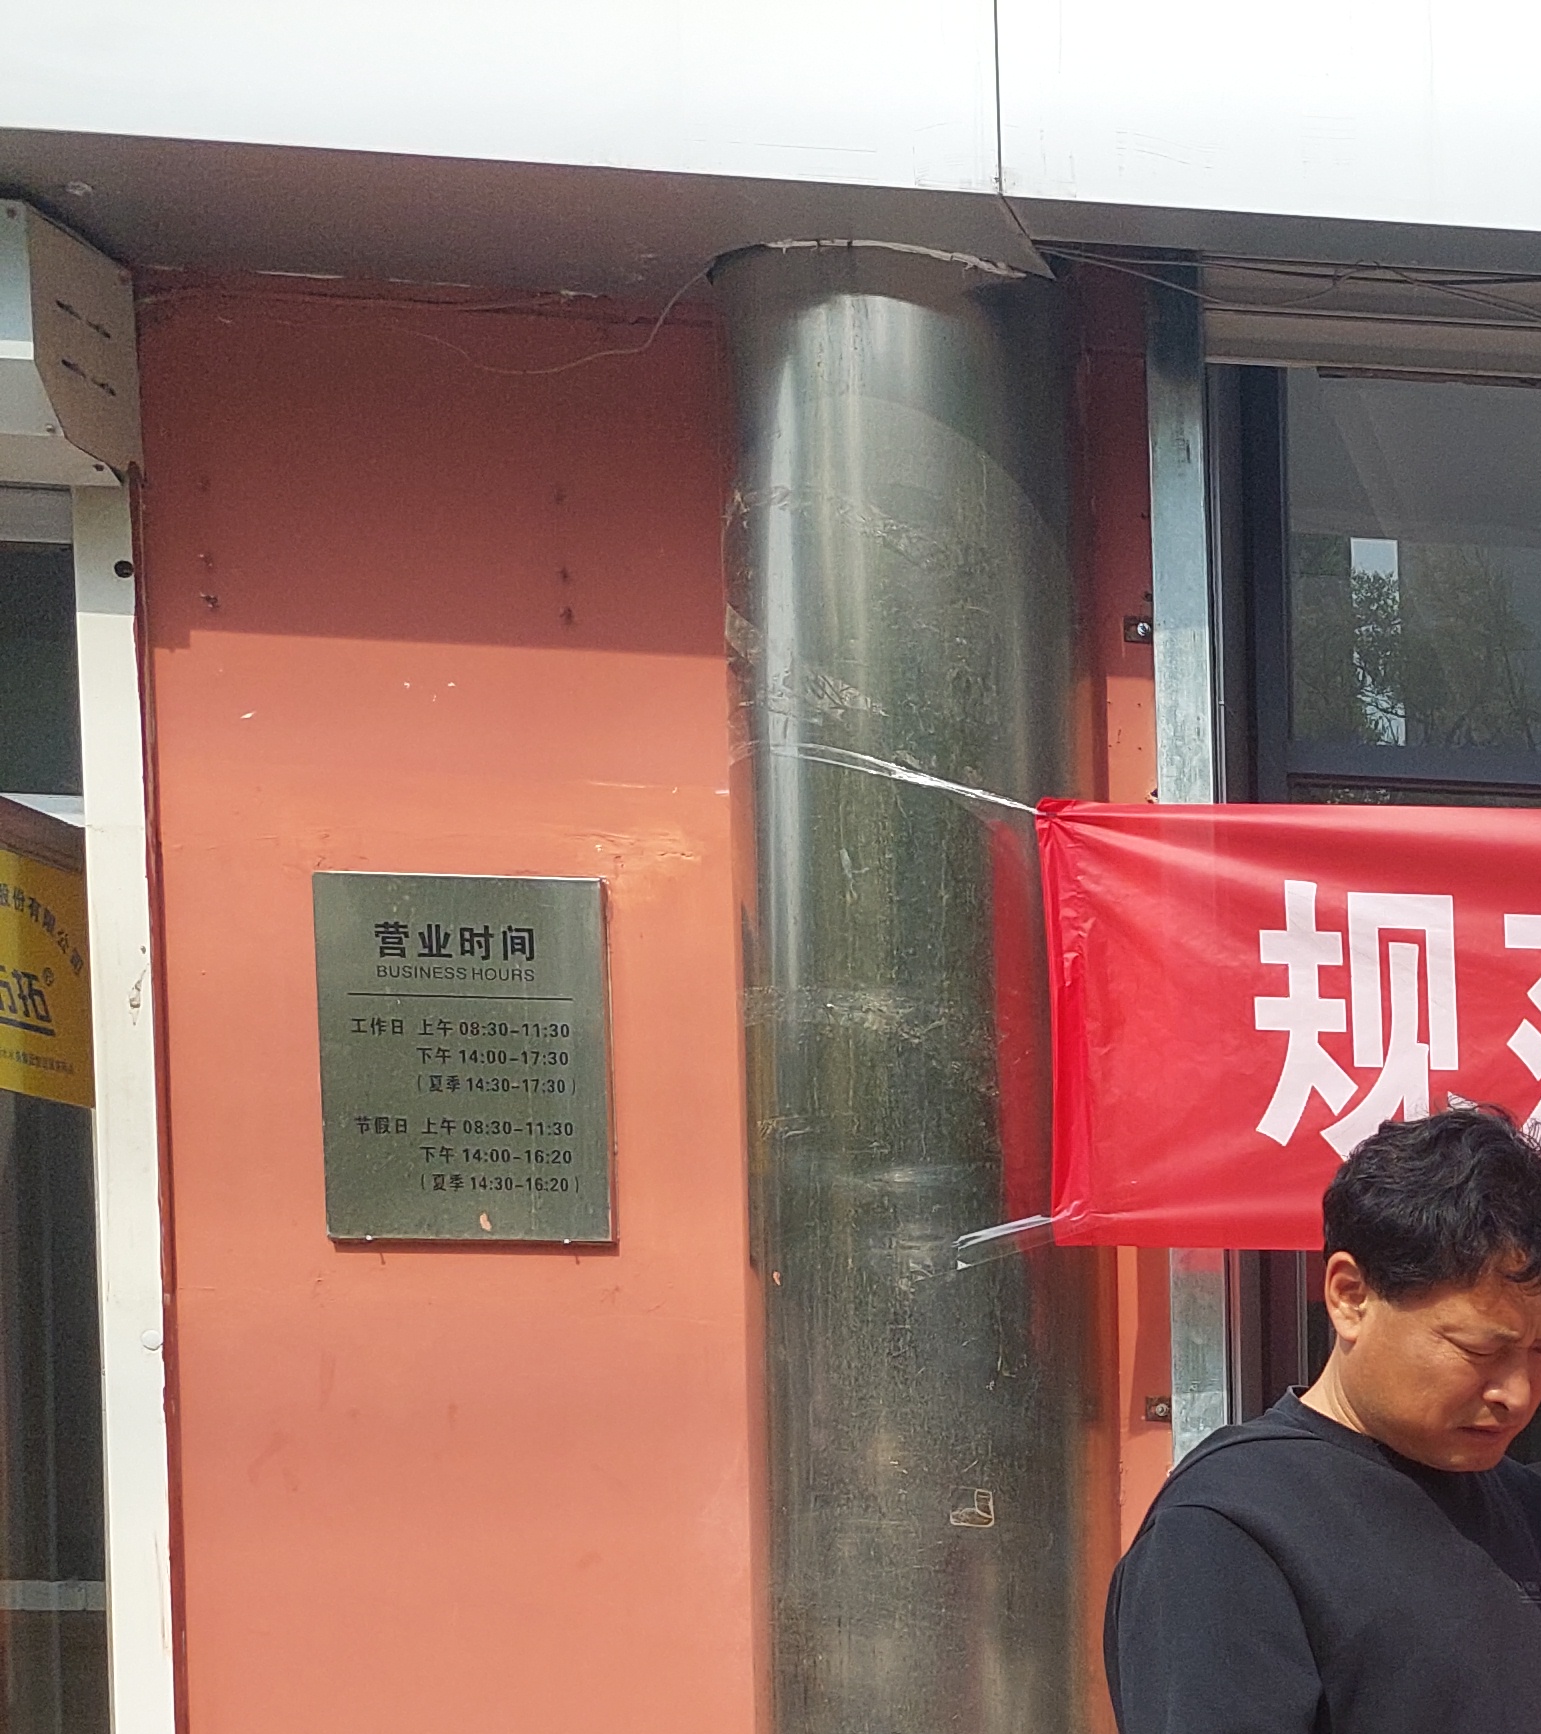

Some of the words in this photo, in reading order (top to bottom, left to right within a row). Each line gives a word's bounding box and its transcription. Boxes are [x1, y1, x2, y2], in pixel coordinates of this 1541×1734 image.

[374, 921, 535, 961] 营业时间
[376, 965, 467, 980] BUSINESS
[472, 967, 535, 982] HOURS
[351, 1017, 405, 1036] 工作日
[417, 1018, 454, 1037] 上午
[459, 1021, 570, 1038] 08:30-11:30
[416, 1046, 452, 1065] 下午
[458, 1049, 569, 1066] 14:00-17:30
[355, 1115, 408, 1135] 节假日
[421, 1117, 457, 1136] 上午
[463, 1120, 574, 1137] 08:30-11:30
[419, 1146, 455, 1164] 下午
[463, 1148, 572, 1165] 14:00-16:20
